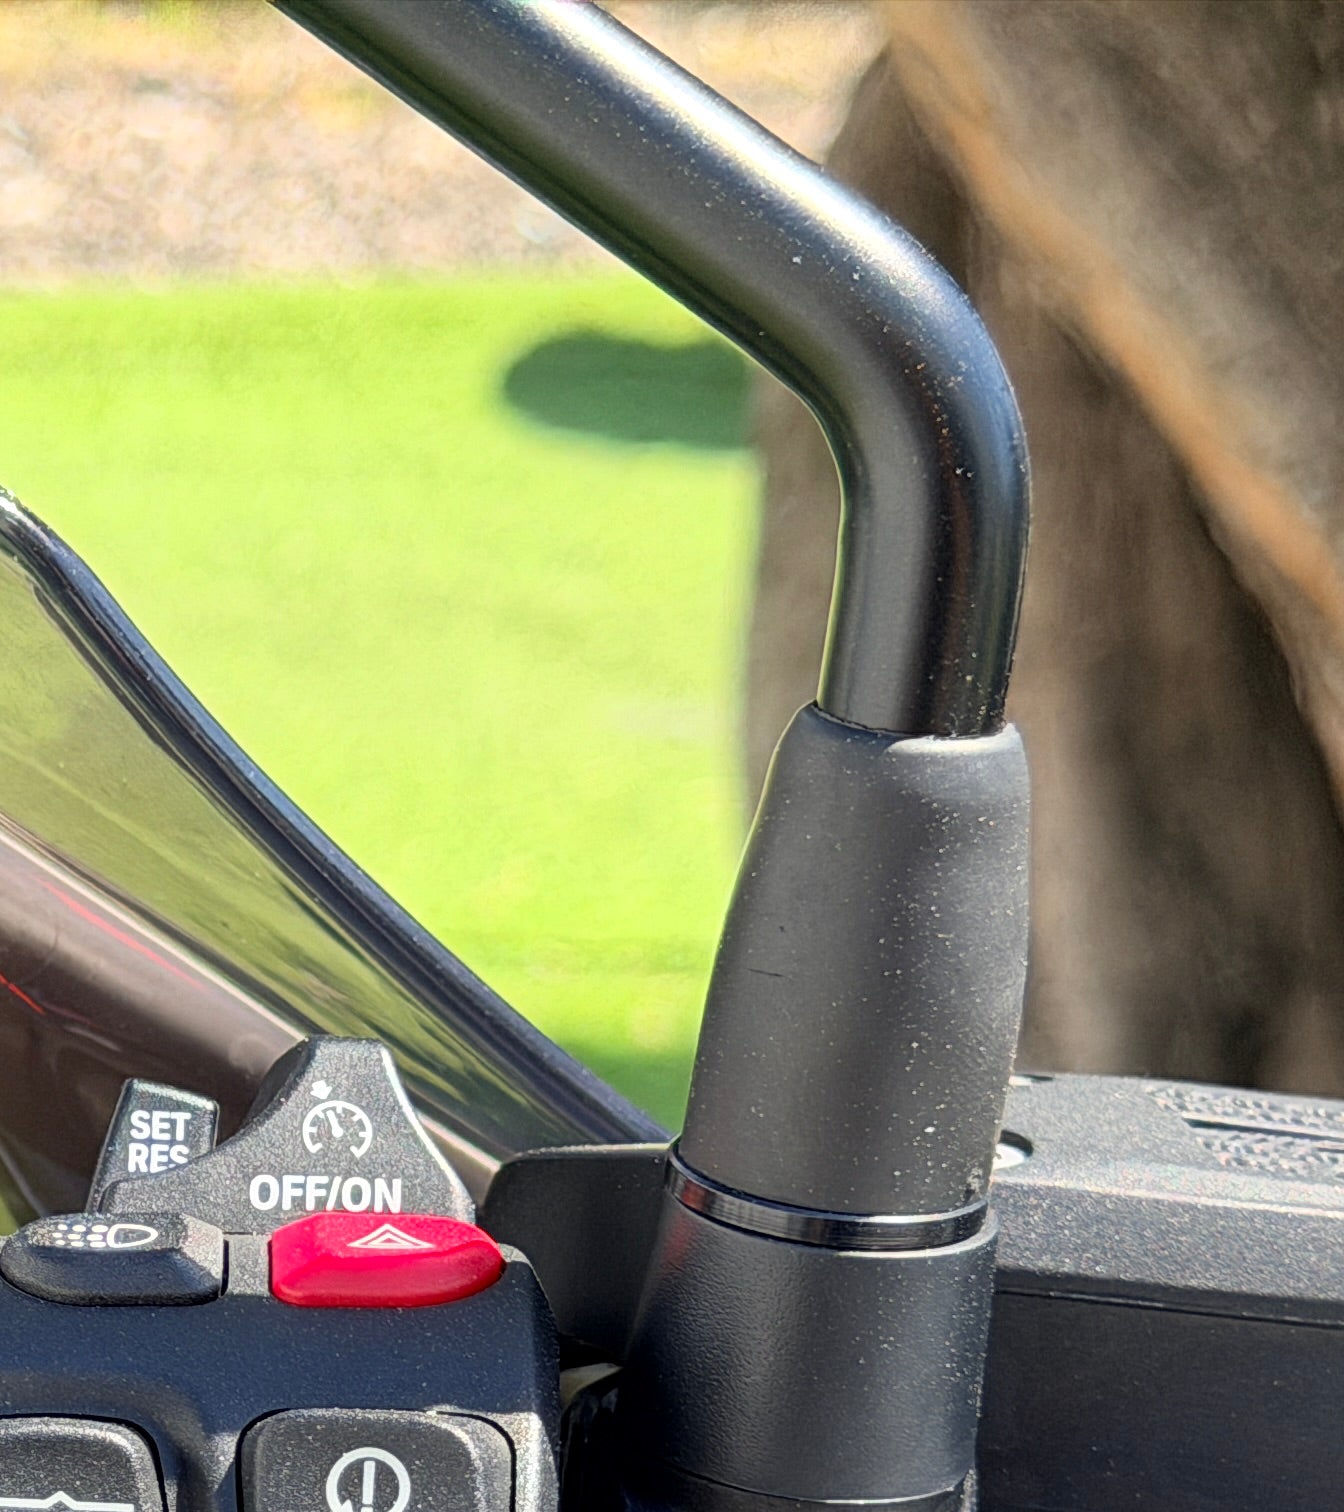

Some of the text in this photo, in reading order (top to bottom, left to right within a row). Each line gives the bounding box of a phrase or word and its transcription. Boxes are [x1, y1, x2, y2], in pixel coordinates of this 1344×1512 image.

[130, 1110, 191, 1141] SET
[128, 1143, 189, 1173] RES
[249, 1174, 402, 1213] OFF/ON
